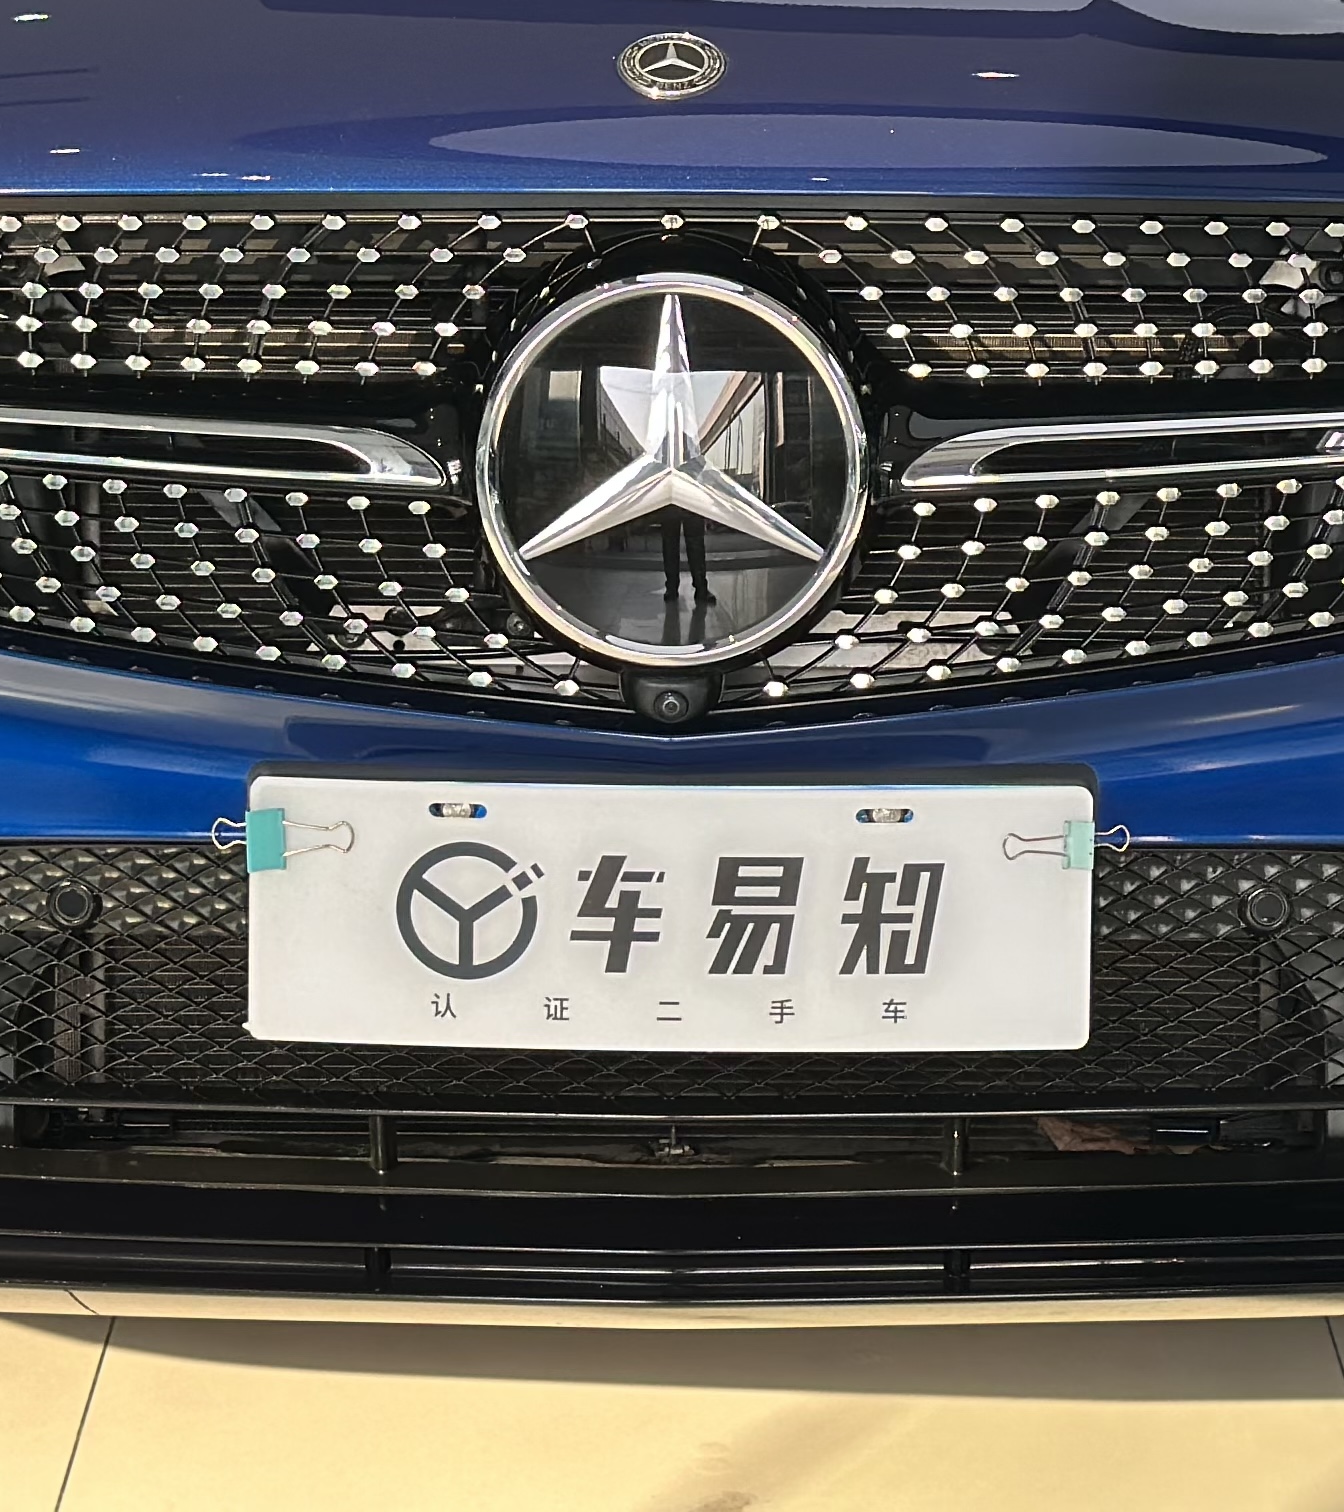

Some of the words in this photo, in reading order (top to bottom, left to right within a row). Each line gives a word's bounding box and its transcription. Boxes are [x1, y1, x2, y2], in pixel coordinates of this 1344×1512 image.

[569, 855, 946, 975] 车易知
[430, 991, 908, 1025] 认证二手车
